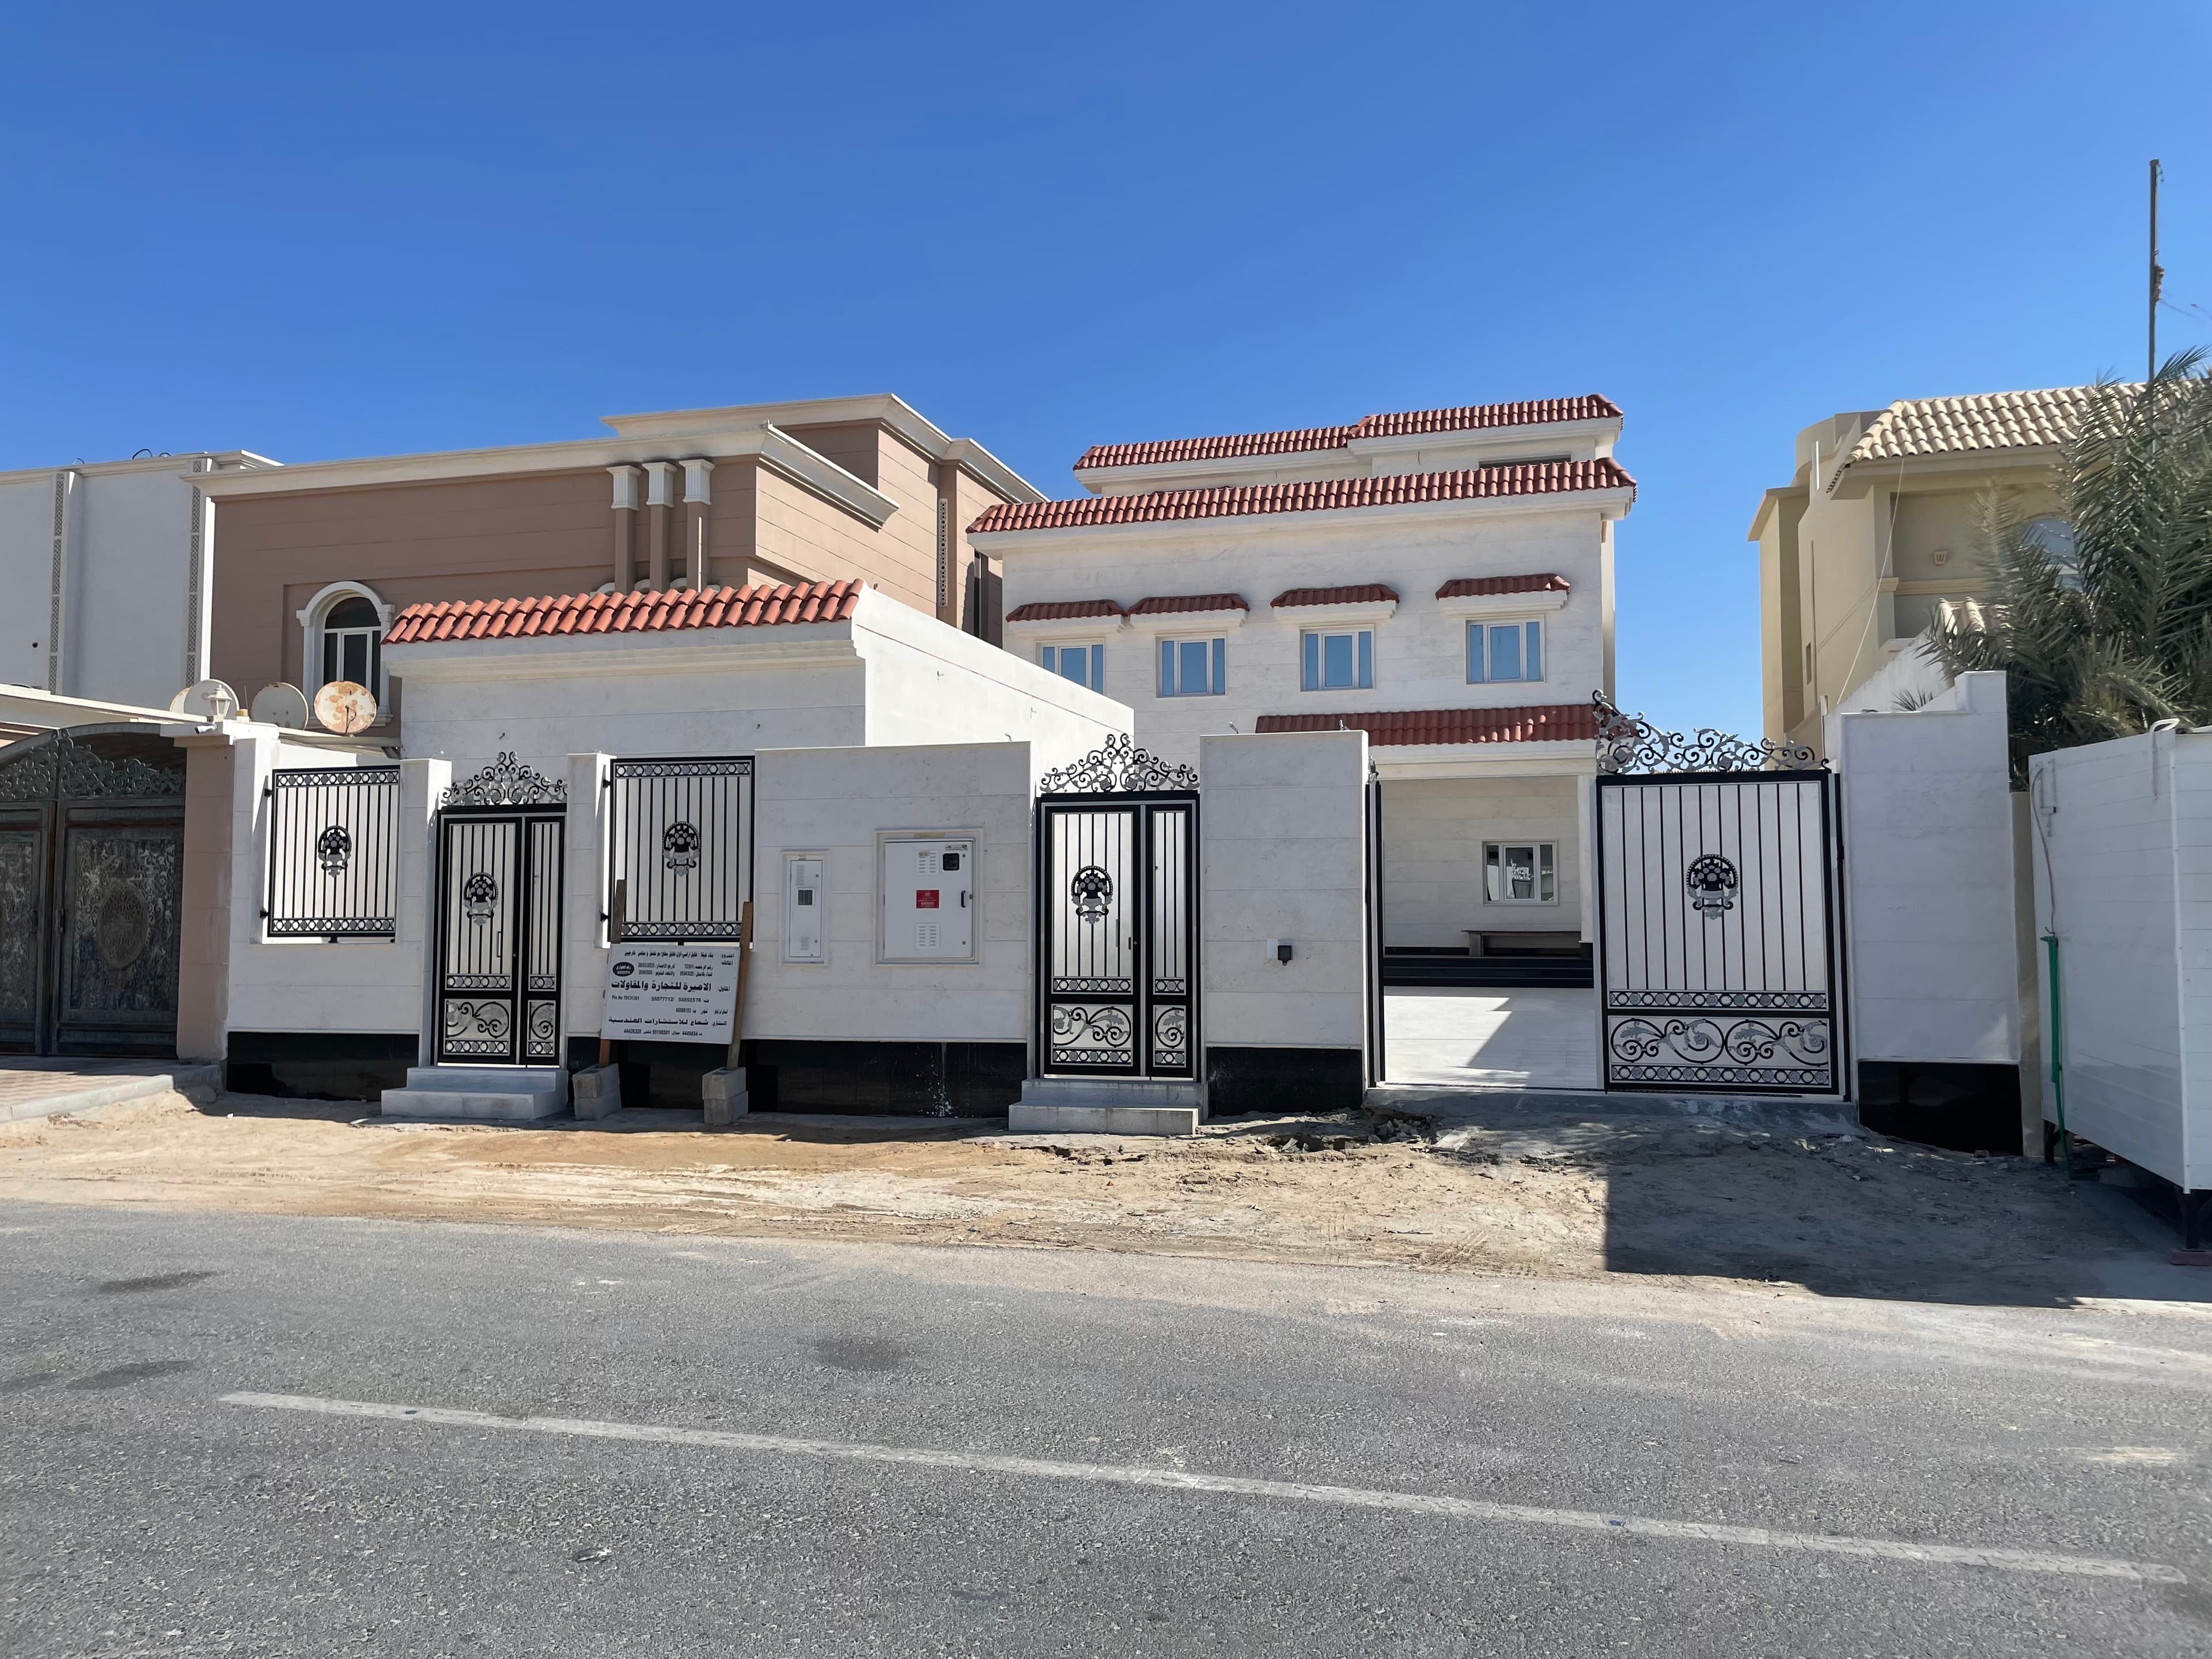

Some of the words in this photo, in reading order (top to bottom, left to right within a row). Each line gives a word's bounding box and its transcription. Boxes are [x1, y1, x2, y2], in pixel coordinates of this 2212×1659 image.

[611, 980, 649, 991] والمقاولات
[652, 980, 681, 991] للتجارة
[683, 982, 711, 993] الاميرة
